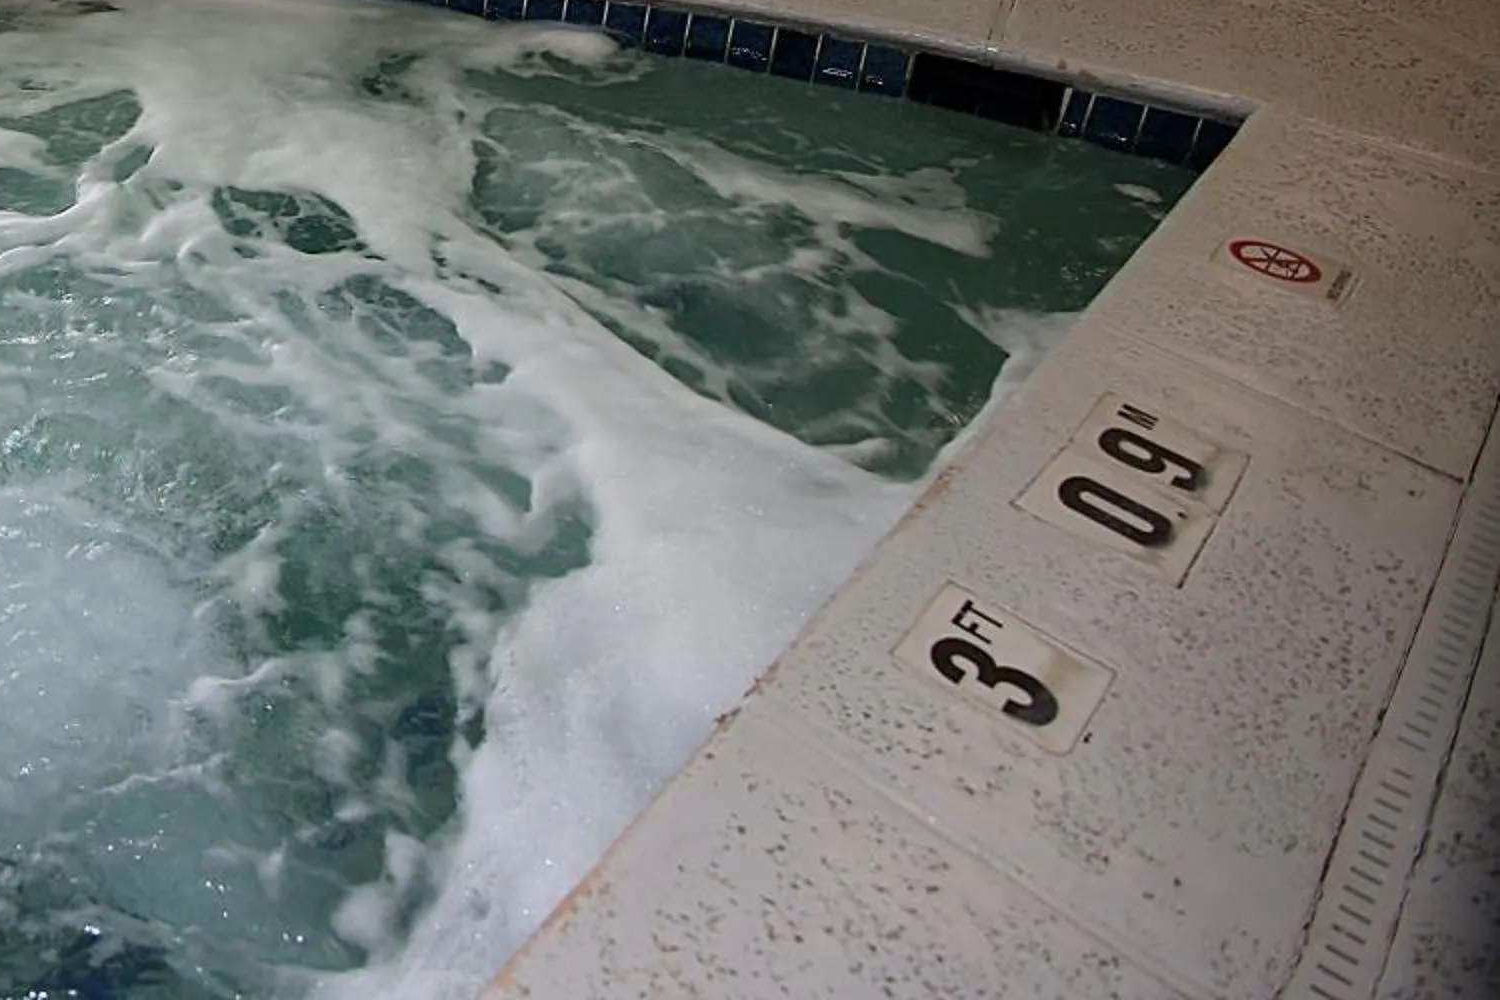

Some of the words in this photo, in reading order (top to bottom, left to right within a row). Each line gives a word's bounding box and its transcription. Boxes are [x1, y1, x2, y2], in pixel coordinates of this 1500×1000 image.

[1116, 402, 1159, 431] M
[1057, 426, 1207, 548] 0.9
[951, 599, 1004, 645] FT
[929, 637, 1060, 727] 3
